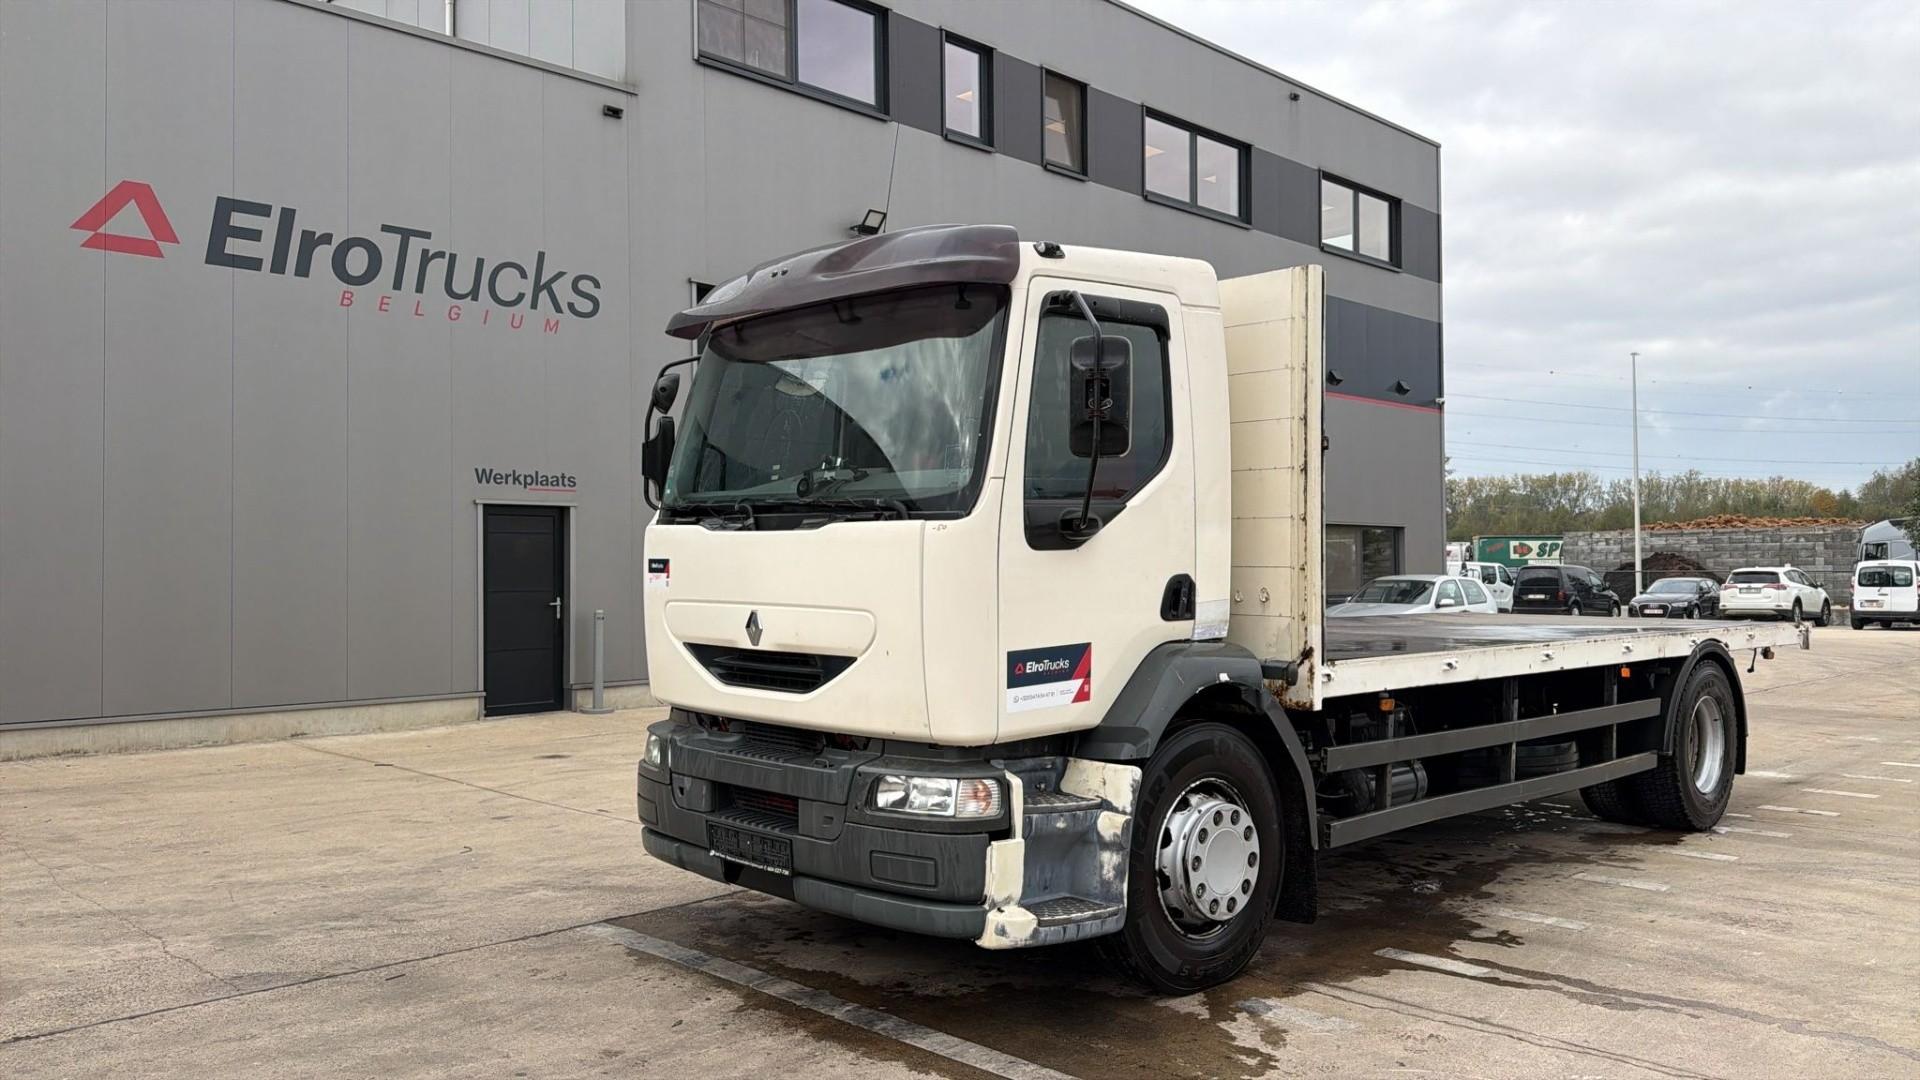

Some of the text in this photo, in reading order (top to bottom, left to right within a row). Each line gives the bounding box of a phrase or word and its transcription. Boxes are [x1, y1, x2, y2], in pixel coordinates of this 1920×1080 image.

[204, 196, 601, 319] ElroTrucks
[340, 290, 560, 335] BELGIUM
[474, 467, 577, 489] Werkplaats
[1536, 542, 1563, 558] SP
[1025, 658, 1070, 673] ElroTrucks
